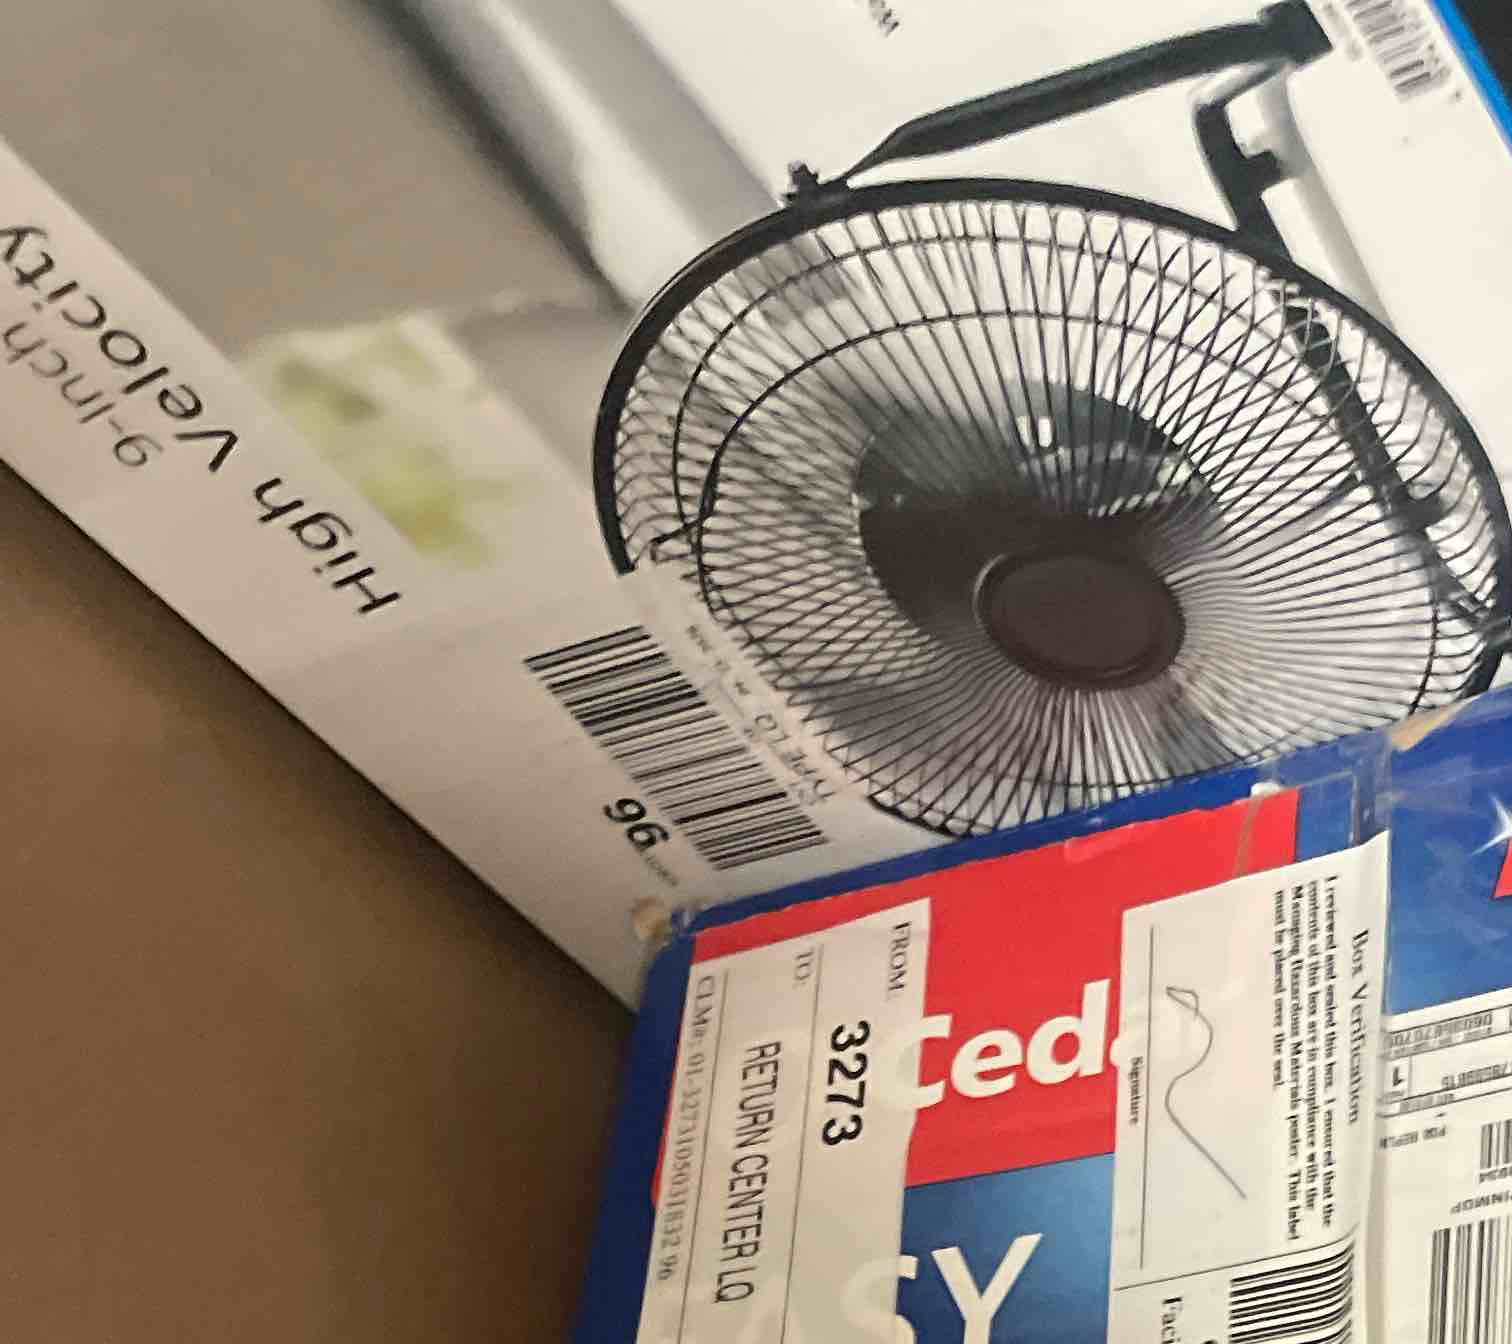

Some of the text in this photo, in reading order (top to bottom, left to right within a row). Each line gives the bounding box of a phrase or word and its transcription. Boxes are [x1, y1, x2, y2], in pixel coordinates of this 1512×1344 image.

[0, 225, 401, 616] High Velocity
[2, 320, 164, 468] 9-Inch
[603, 797, 671, 848] 96
[822, 1019, 871, 1147] 3273
[1127, 1056, 1145, 1127] Signature
[1349, 929, 1369, 1124] Box Verification
[713, 1040, 783, 1305] RETURN CENTER LQ
